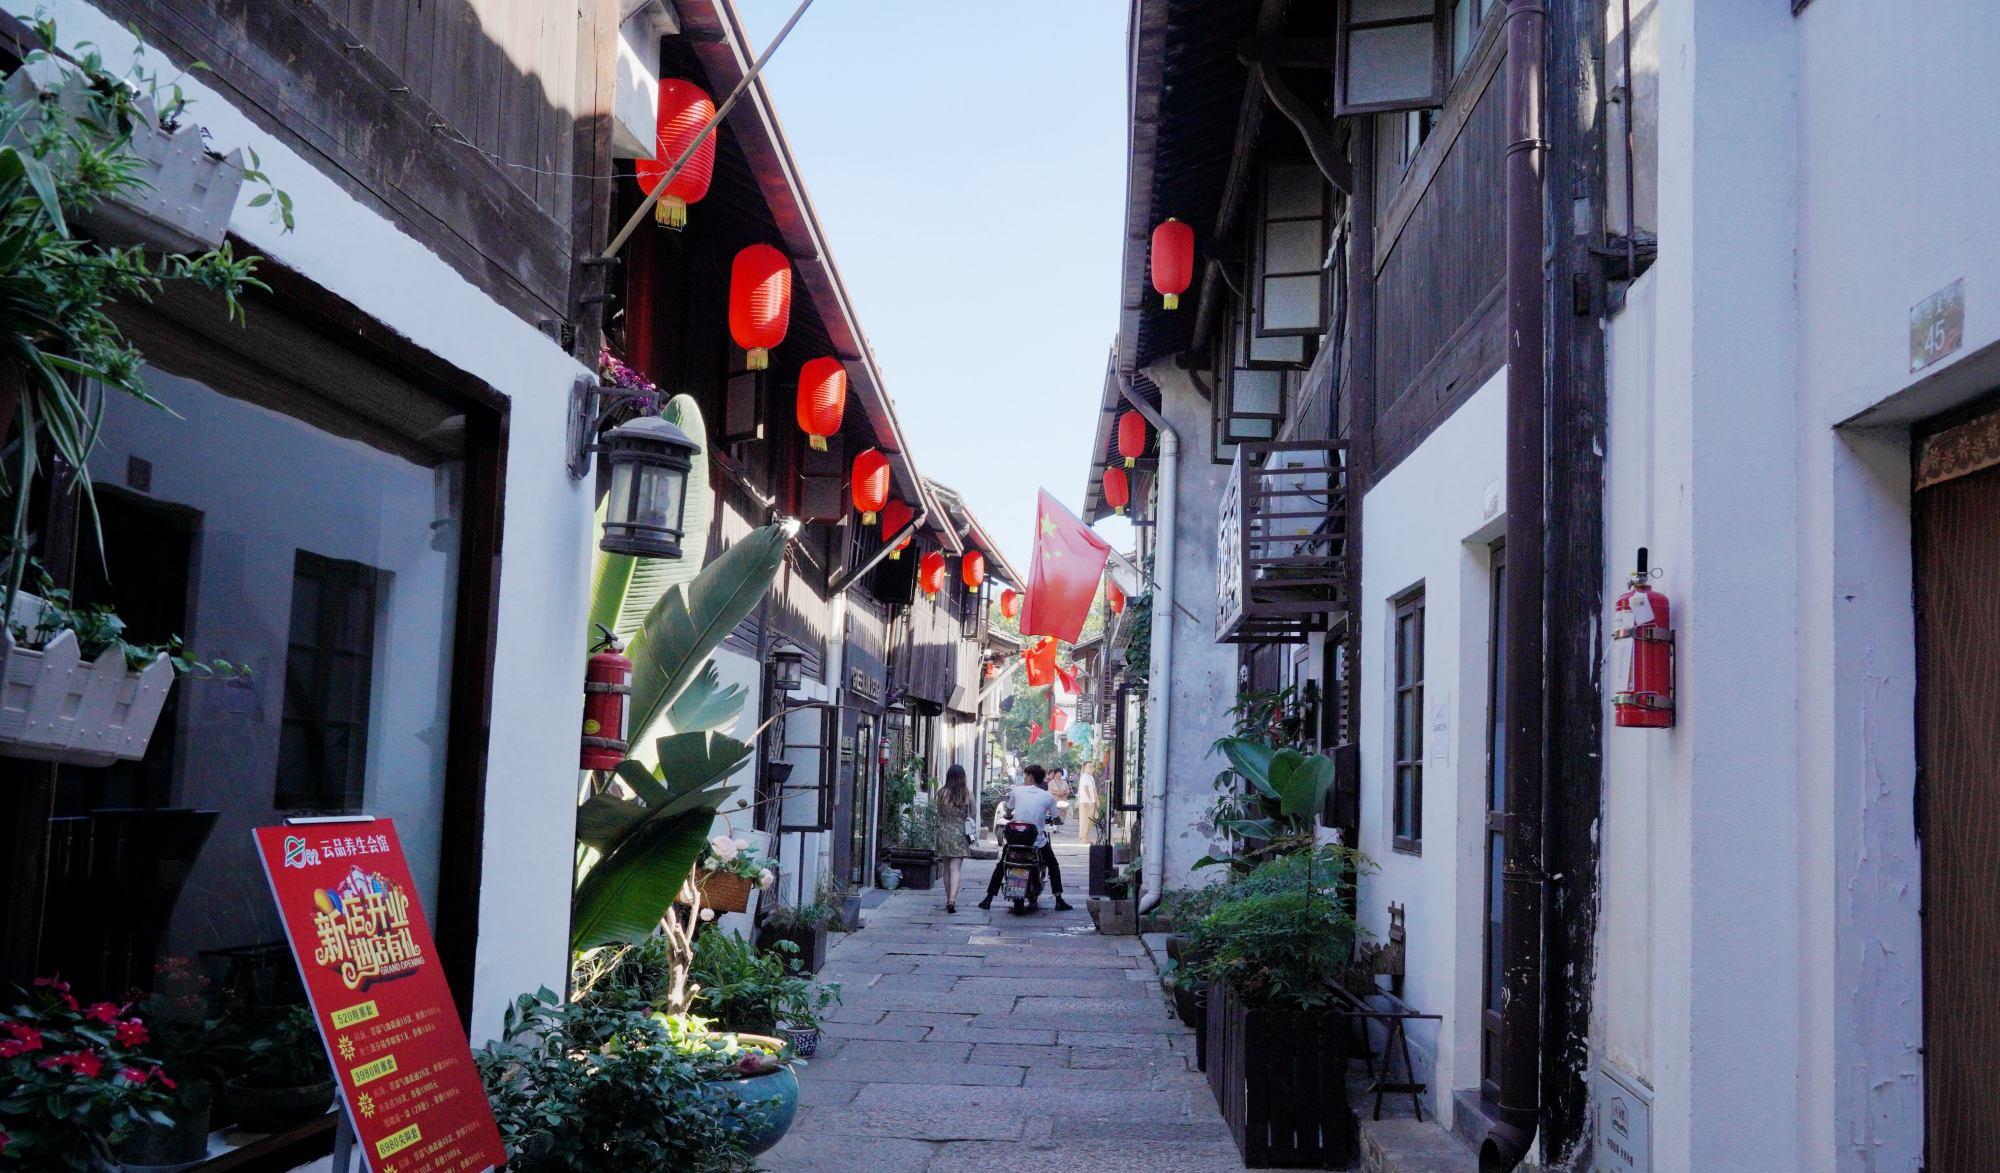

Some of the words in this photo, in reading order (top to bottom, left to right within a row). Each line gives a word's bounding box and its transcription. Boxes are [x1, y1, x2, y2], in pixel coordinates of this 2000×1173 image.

[1924, 319, 1946, 355] 45
[320, 834, 390, 859] 云品养生会馆
[314, 891, 409, 966] 新店开业
[380, 963, 401, 976] GRAND
[401, 957, 425, 970] OPENING
